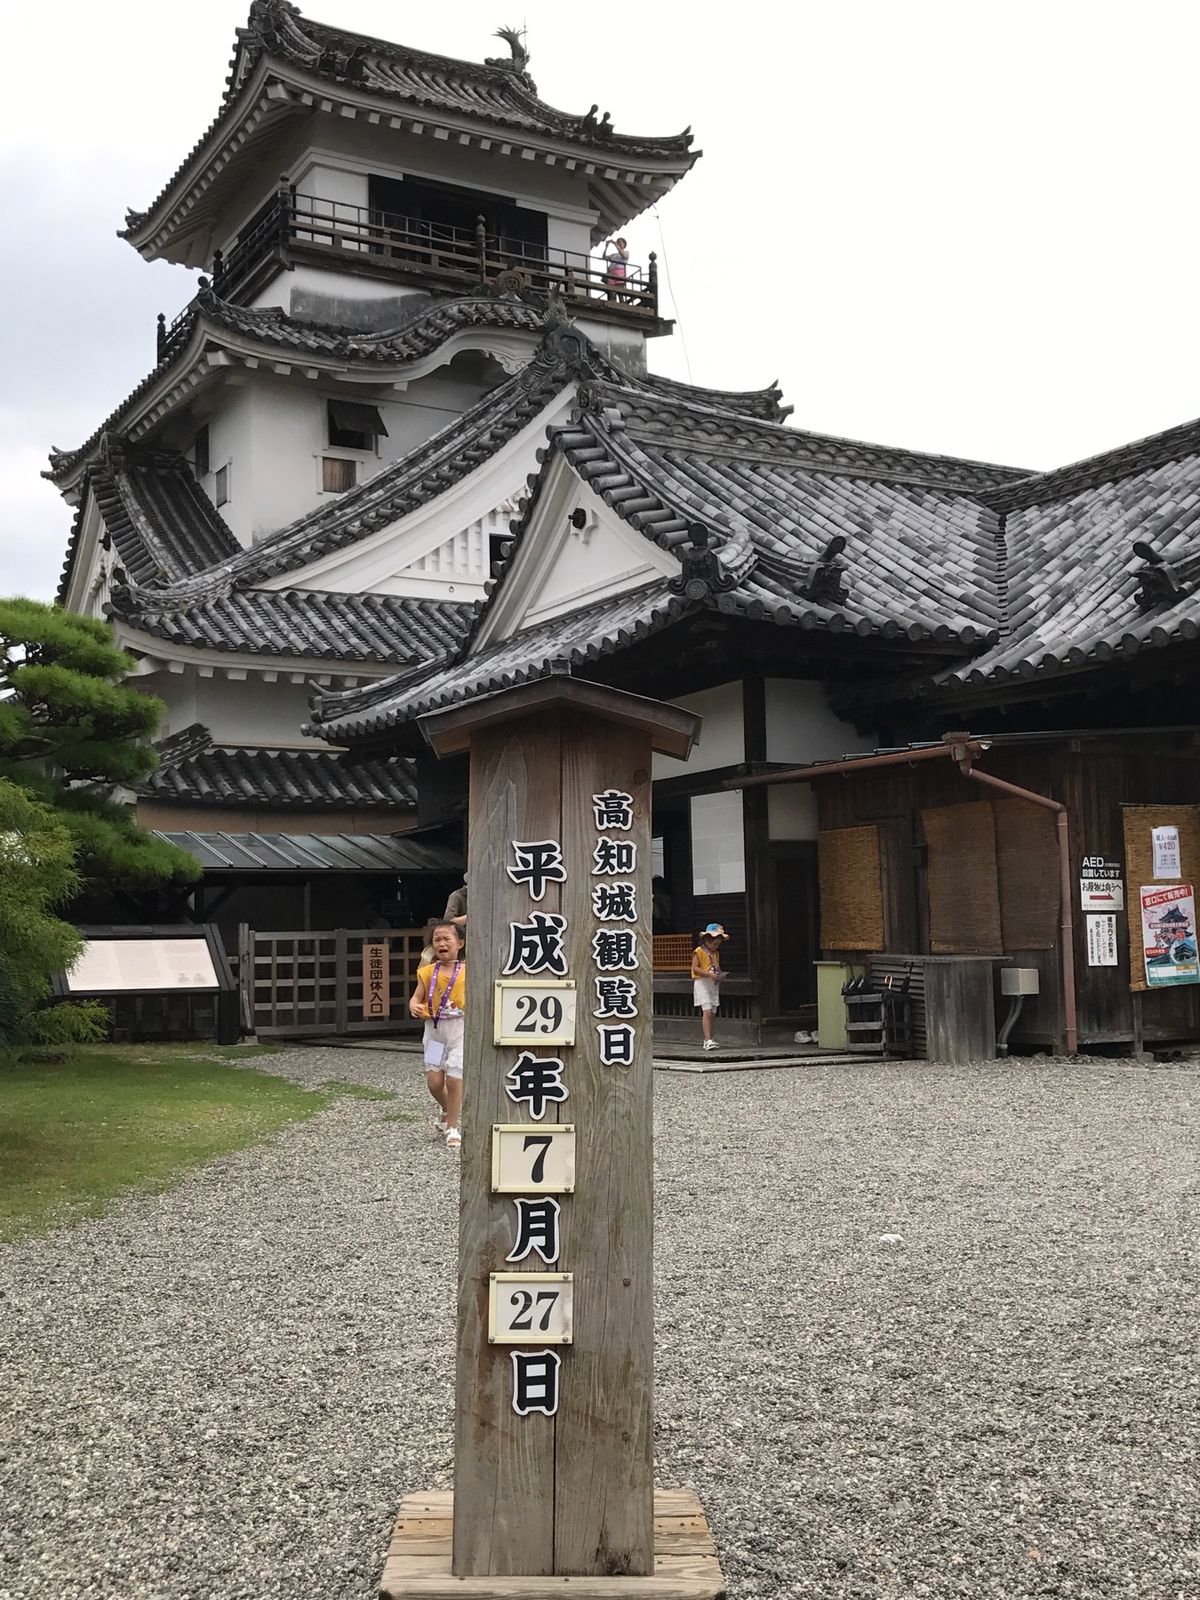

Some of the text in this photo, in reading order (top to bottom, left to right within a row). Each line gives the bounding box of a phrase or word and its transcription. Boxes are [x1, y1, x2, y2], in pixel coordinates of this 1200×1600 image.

[1082, 856, 1104, 868] AED
[1082, 868, 1121, 878] 設置しています
[592, 790, 639, 1065] 高知城観覧日
[369, 947, 383, 1014] 生徒団体入口
